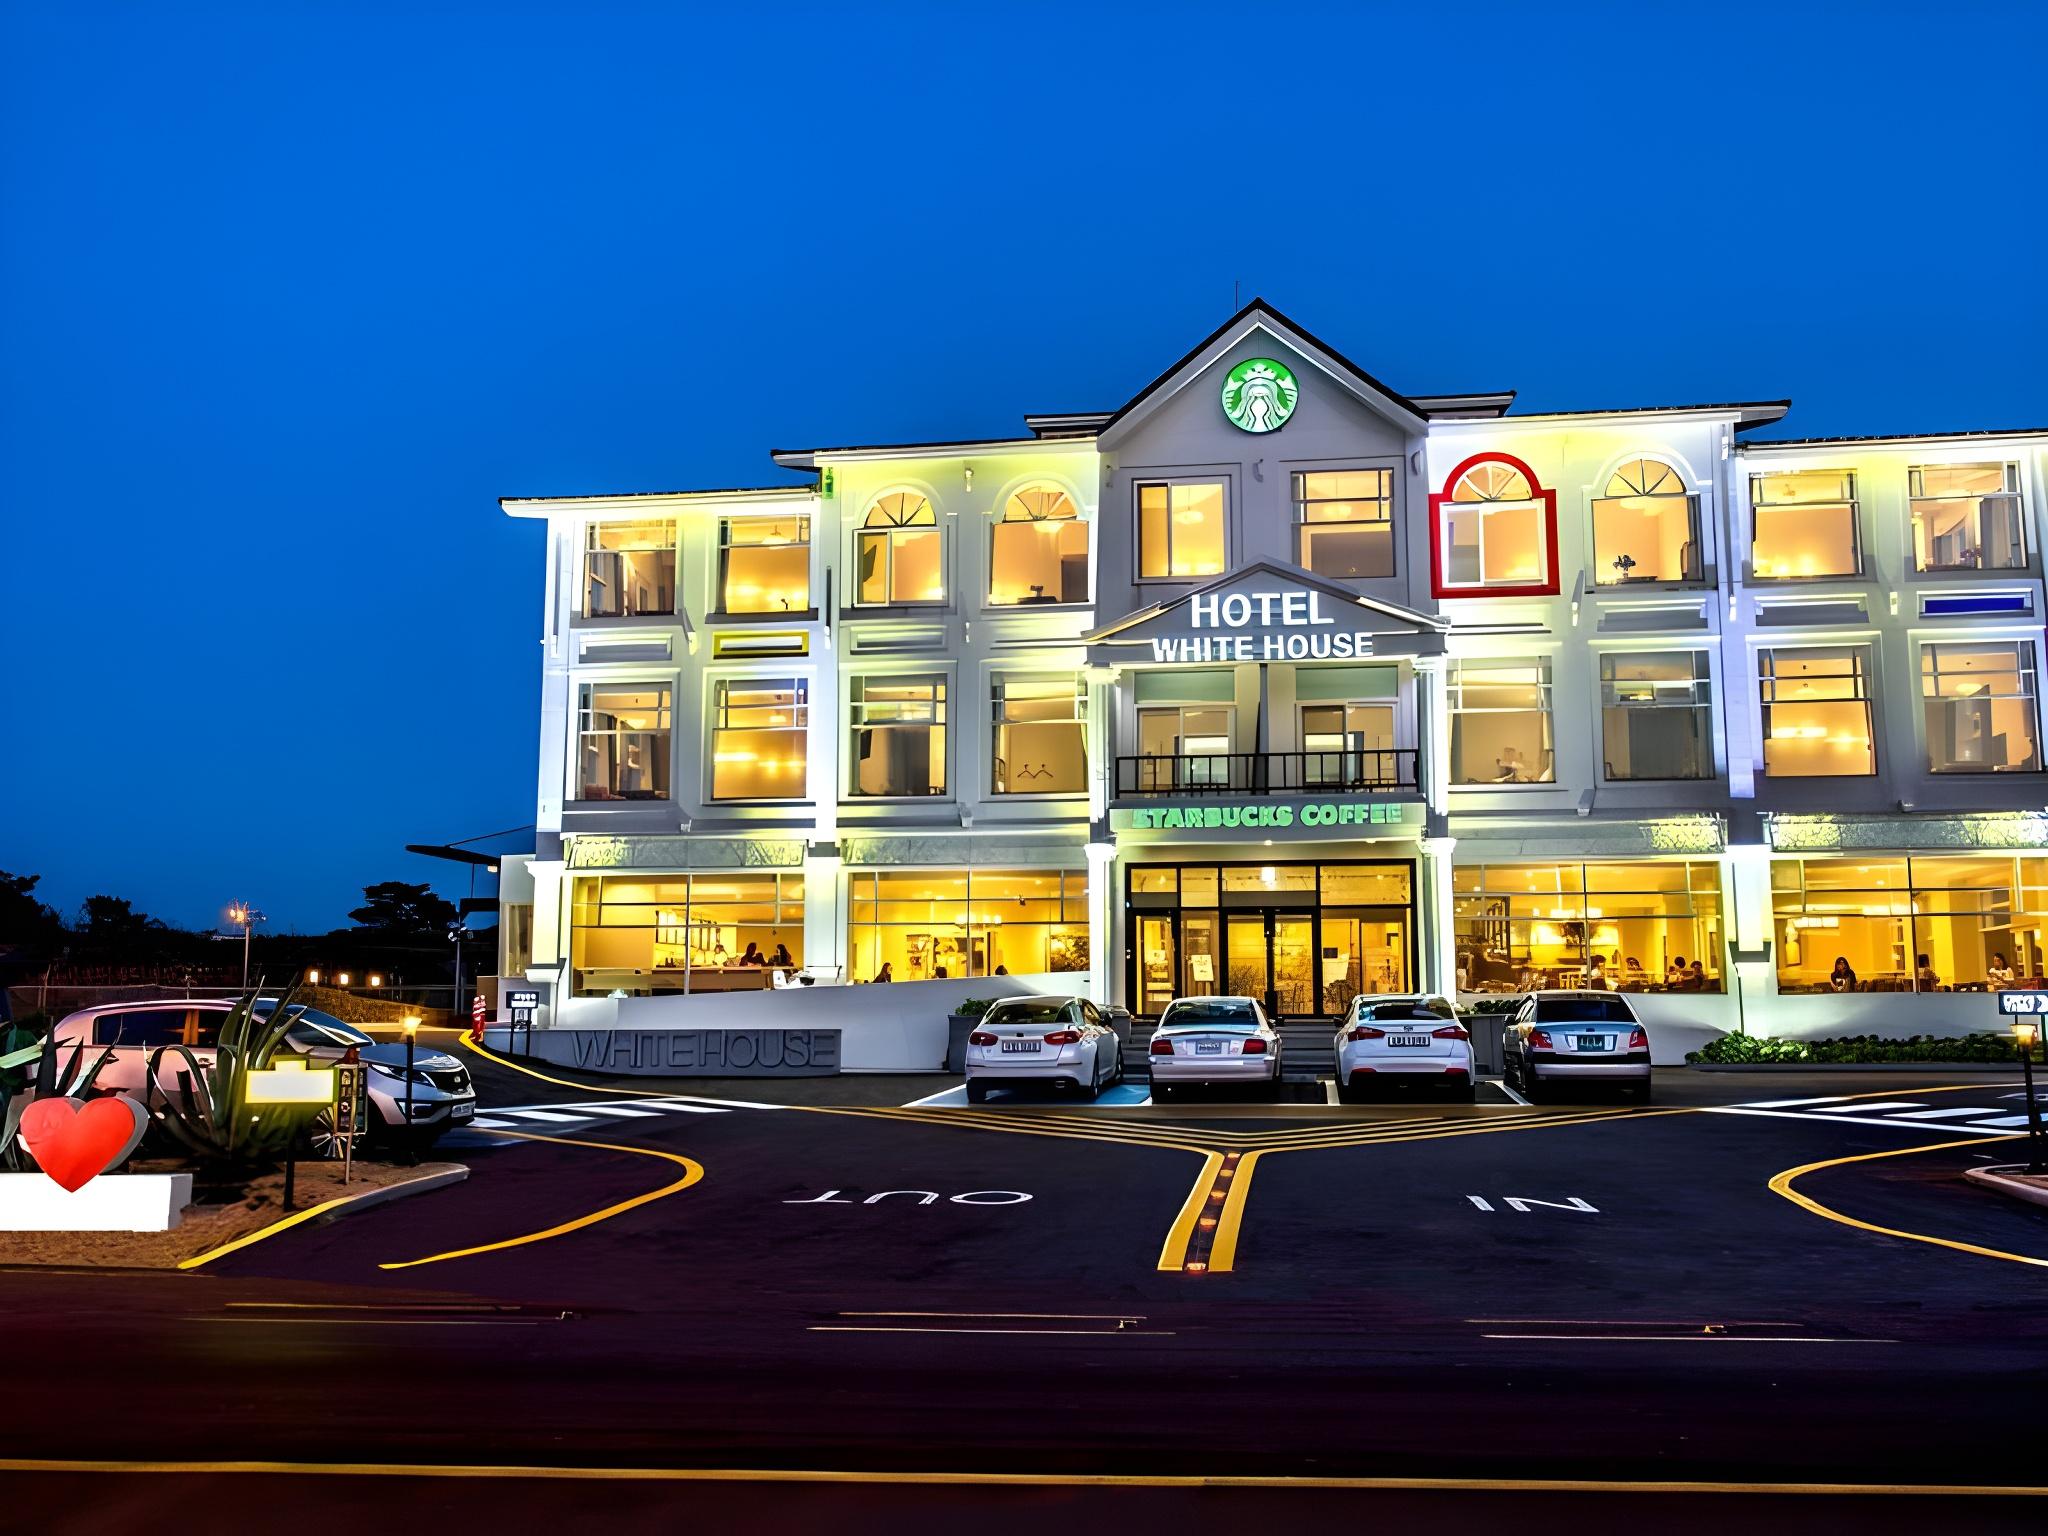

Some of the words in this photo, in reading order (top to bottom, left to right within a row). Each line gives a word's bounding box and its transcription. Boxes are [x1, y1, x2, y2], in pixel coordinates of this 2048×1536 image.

[1191, 591, 1335, 628] HOTEL
[1152, 636, 1254, 662] WHITE
[1263, 632, 1374, 660] HOUSE
[1131, 805, 1294, 828] STARBUCKS
[1300, 804, 1402, 826] COFFEE
[1465, 1195, 1600, 1212] IN
